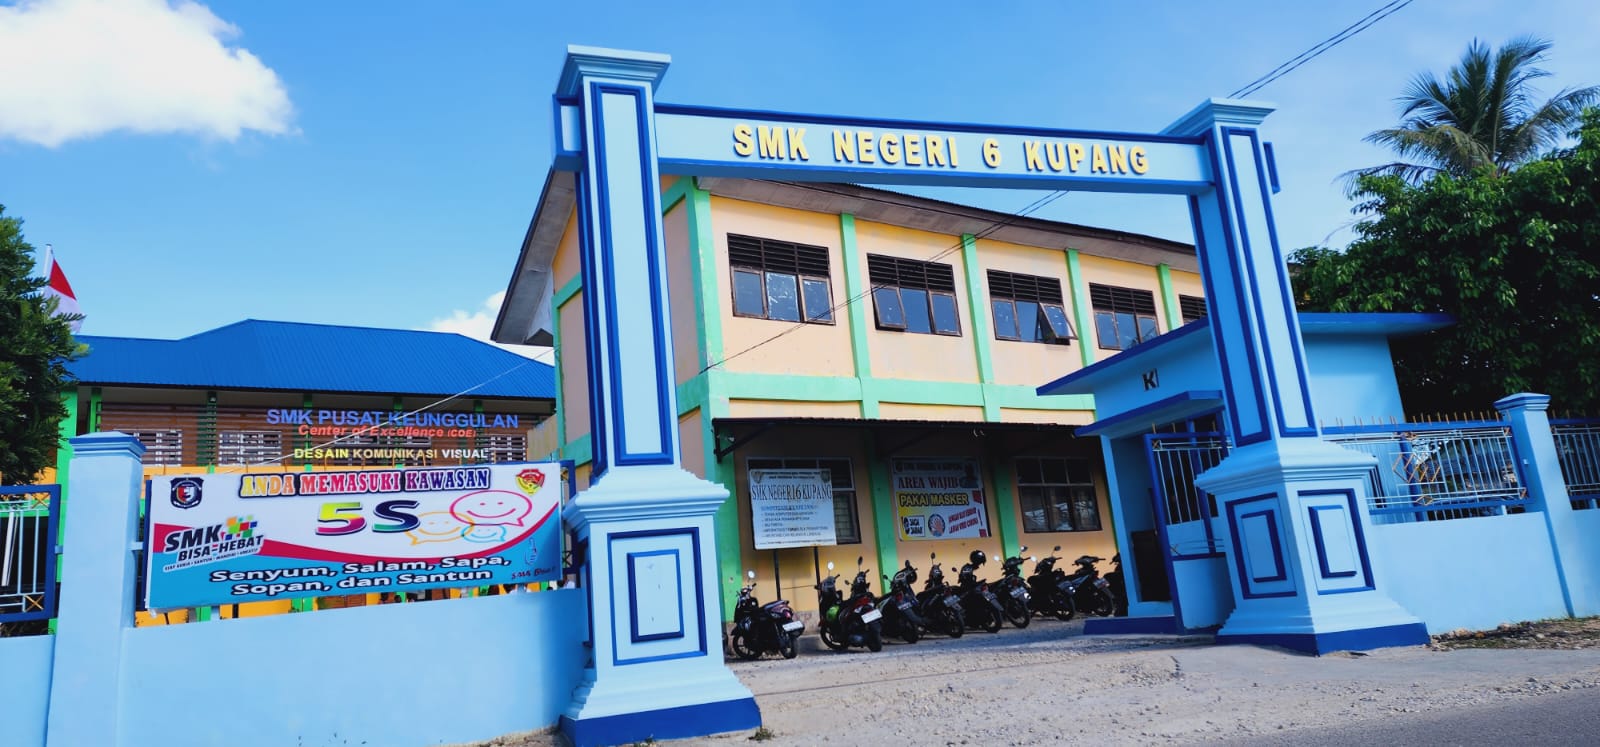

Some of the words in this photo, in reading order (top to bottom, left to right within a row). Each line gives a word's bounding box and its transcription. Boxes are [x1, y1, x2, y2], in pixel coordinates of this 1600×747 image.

[733, 124, 809, 161] SMK
[832, 129, 959, 167] NEGERI
[982, 138, 1001, 168] 6
[1024, 140, 1150, 175] KUPANG
[266, 409, 313, 425] SMK
[318, 410, 384, 426] PUSAT
[388, 412, 519, 429] KEUNGGULAN
[298, 424, 348, 436] Center
[352, 425, 368, 436] of
[369, 426, 444, 437] Excellence
[447, 429, 477, 438] (COE)
[294, 448, 349, 459] DESAIN
[352, 448, 438, 459] KOMUNIKASI
[441, 448, 488, 459] VISUAL
[240, 474, 296, 497] ANDA
[299, 471, 402, 496] MEMASUKI
[404, 469, 489, 491] KAWASAN
[802, 484, 832, 500] KUPANG
[898, 476, 926, 489] AREA
[900, 493, 929, 507] PAKAI
[930, 492, 969, 506] MASKER
[164, 524, 223, 553] SMK
[211, 566, 337, 582] Senyum,
[343, 560, 435, 574] Salam,
[441, 556, 510, 569] Sapa,
[232, 580, 331, 596] Sopan,
[338, 576, 391, 587] dan
[398, 570, 491, 585] Santun
